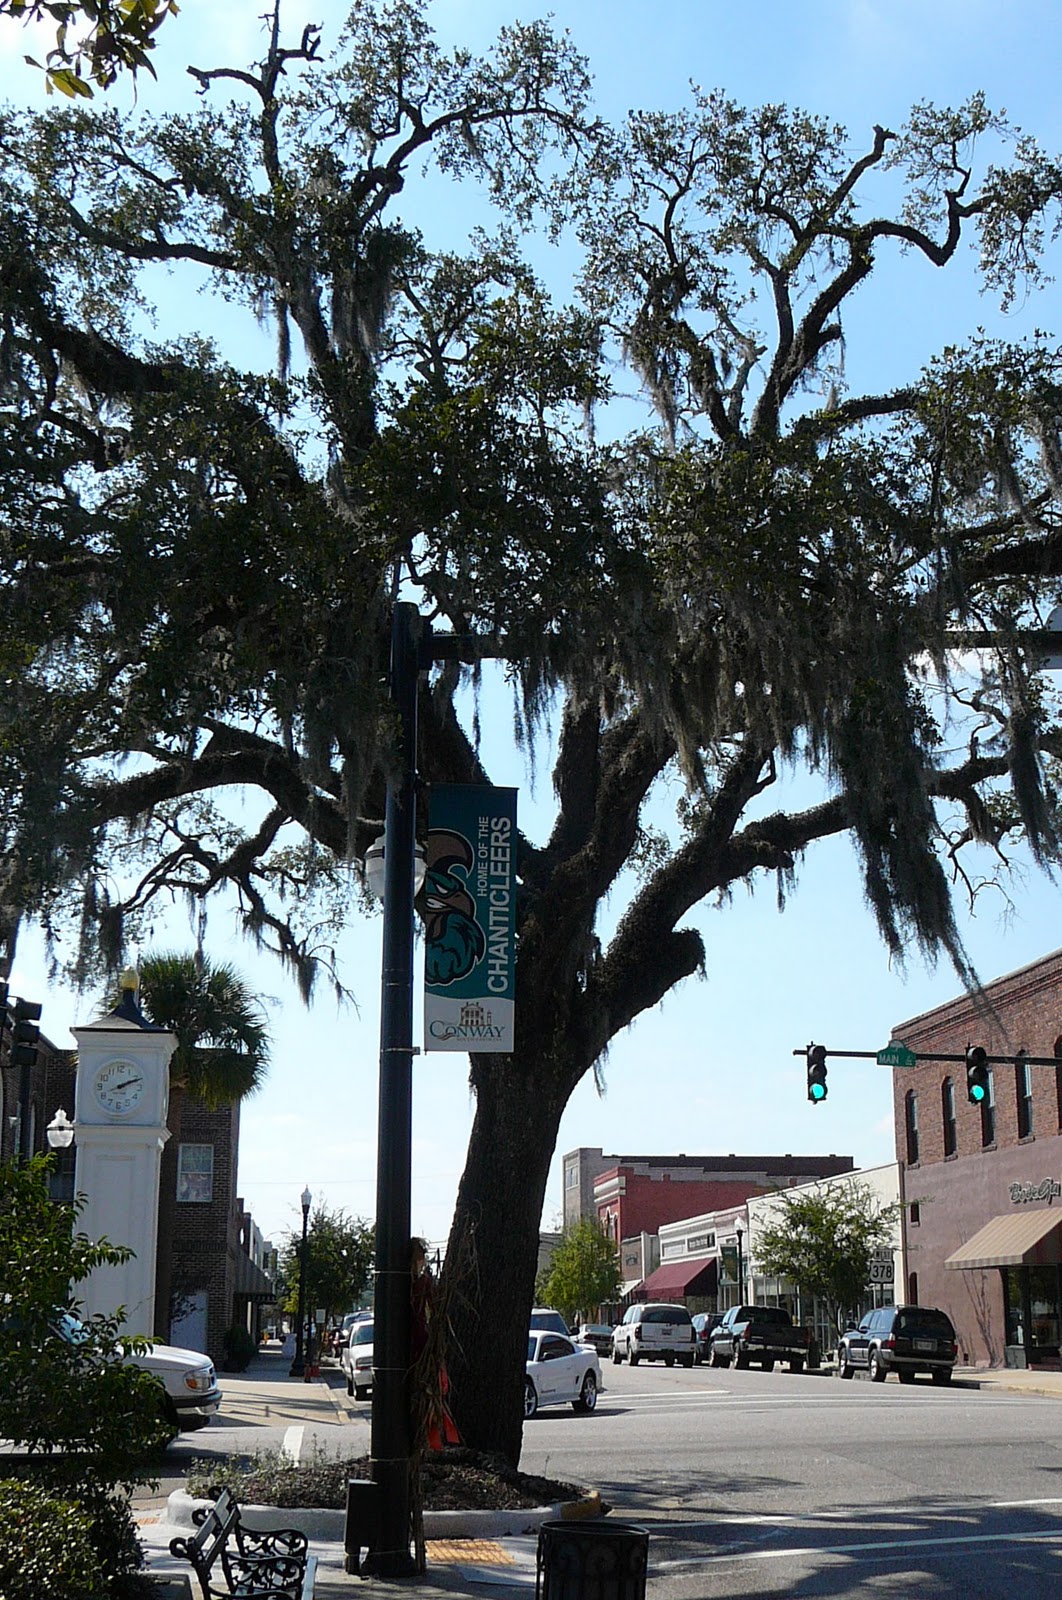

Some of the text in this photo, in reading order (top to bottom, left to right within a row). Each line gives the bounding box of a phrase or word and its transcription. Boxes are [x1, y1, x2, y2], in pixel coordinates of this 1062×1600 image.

[477, 816, 488, 897] HOME OF THE
[487, 816, 511, 993] CHANTICLEERS
[878, 1053, 899, 1064] MAIN
[117, 1065, 125, 1073] 12
[100, 1074, 108, 1082] 10
[872, 1265, 892, 1278] 378
